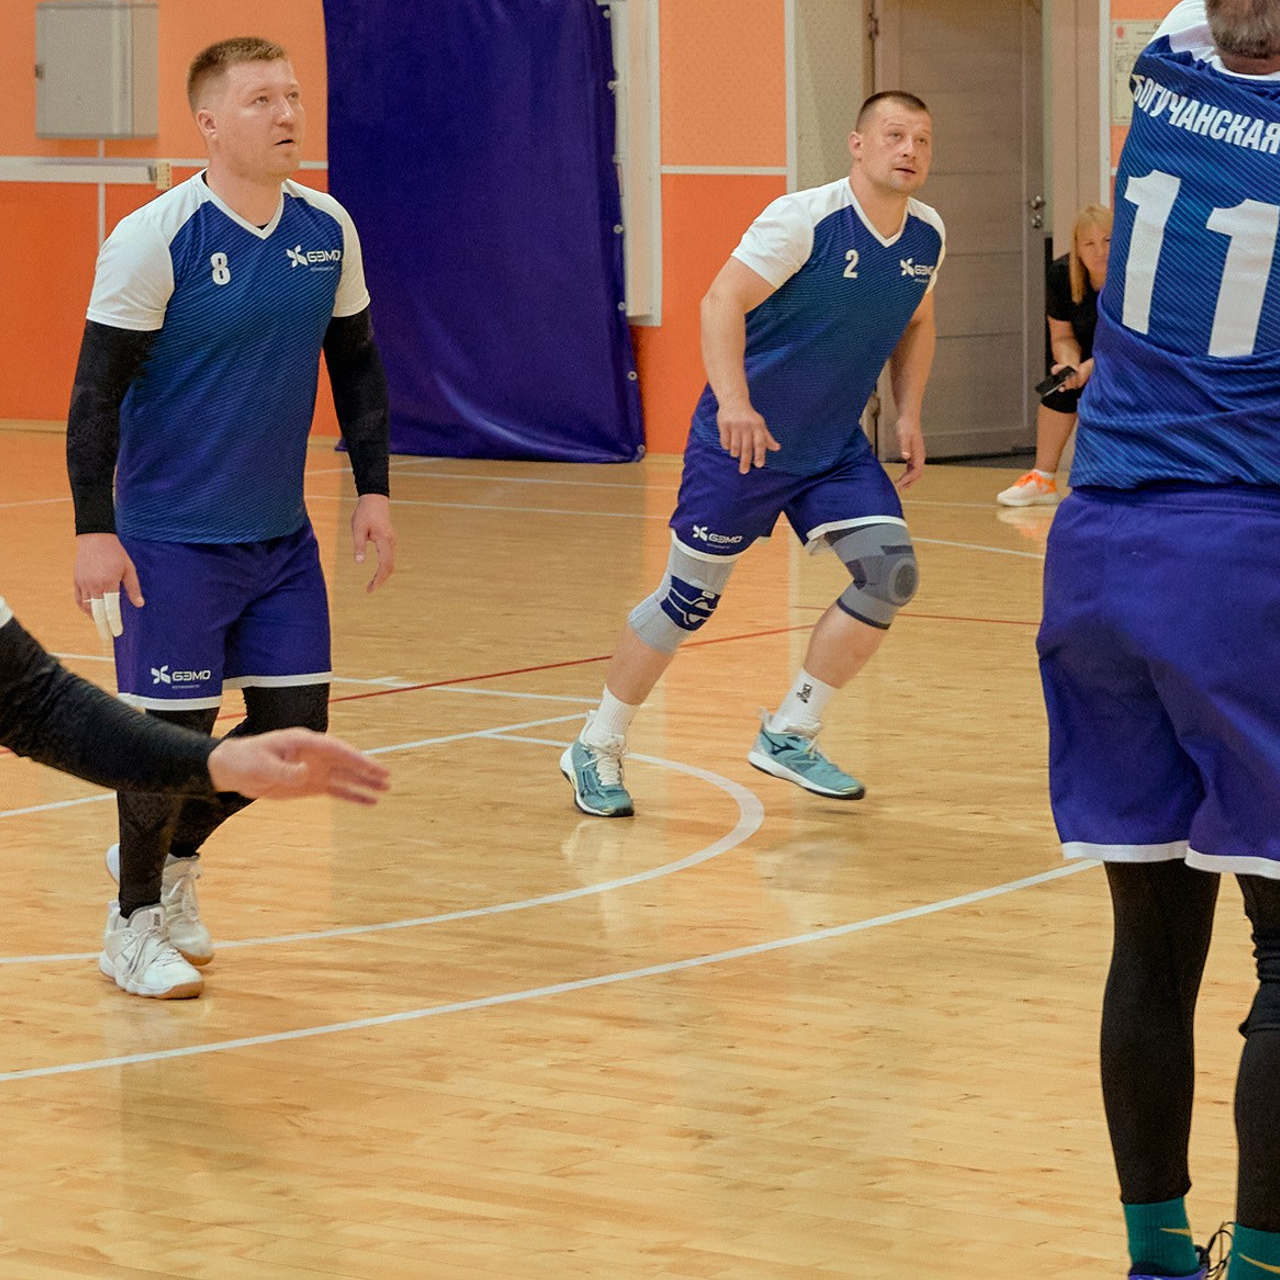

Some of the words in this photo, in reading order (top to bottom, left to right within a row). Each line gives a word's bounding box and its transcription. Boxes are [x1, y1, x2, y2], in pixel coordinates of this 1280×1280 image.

[210, 252, 231, 285] 8
[843, 249, 859, 278] 2
[1121, 168, 1280, 359] 11
